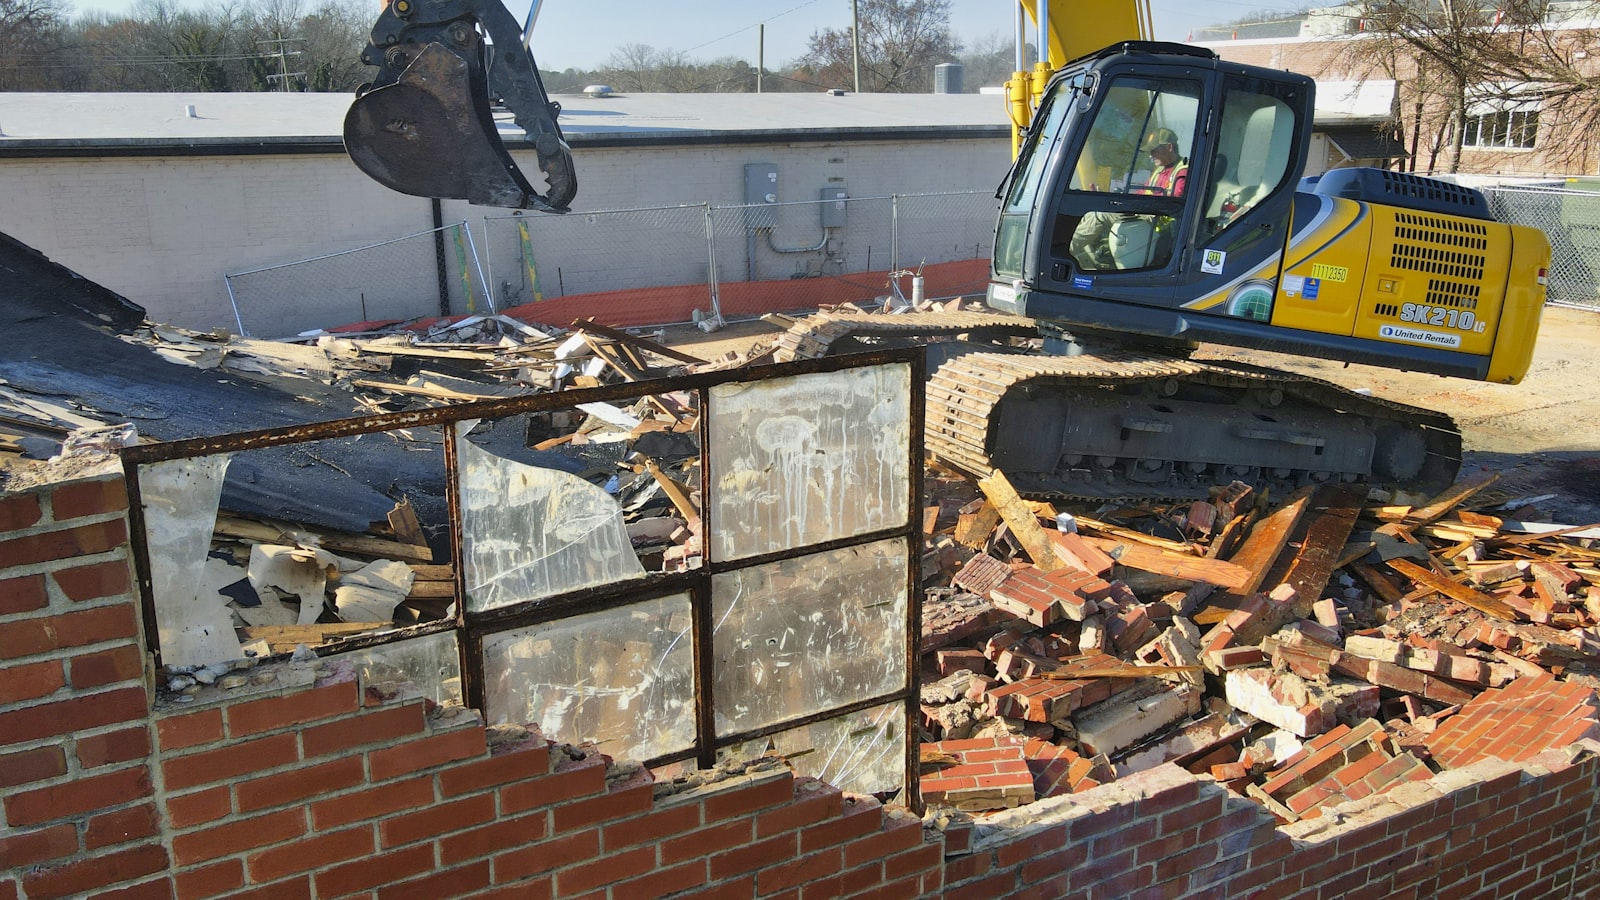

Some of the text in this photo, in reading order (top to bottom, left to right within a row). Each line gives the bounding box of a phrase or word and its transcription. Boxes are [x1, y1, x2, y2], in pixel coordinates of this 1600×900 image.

[1208, 250, 1222, 262] 811
[1312, 264, 1347, 281] 11112350
[1400, 302, 1476, 331] SK210
[1394, 328, 1457, 345] United Rentals
